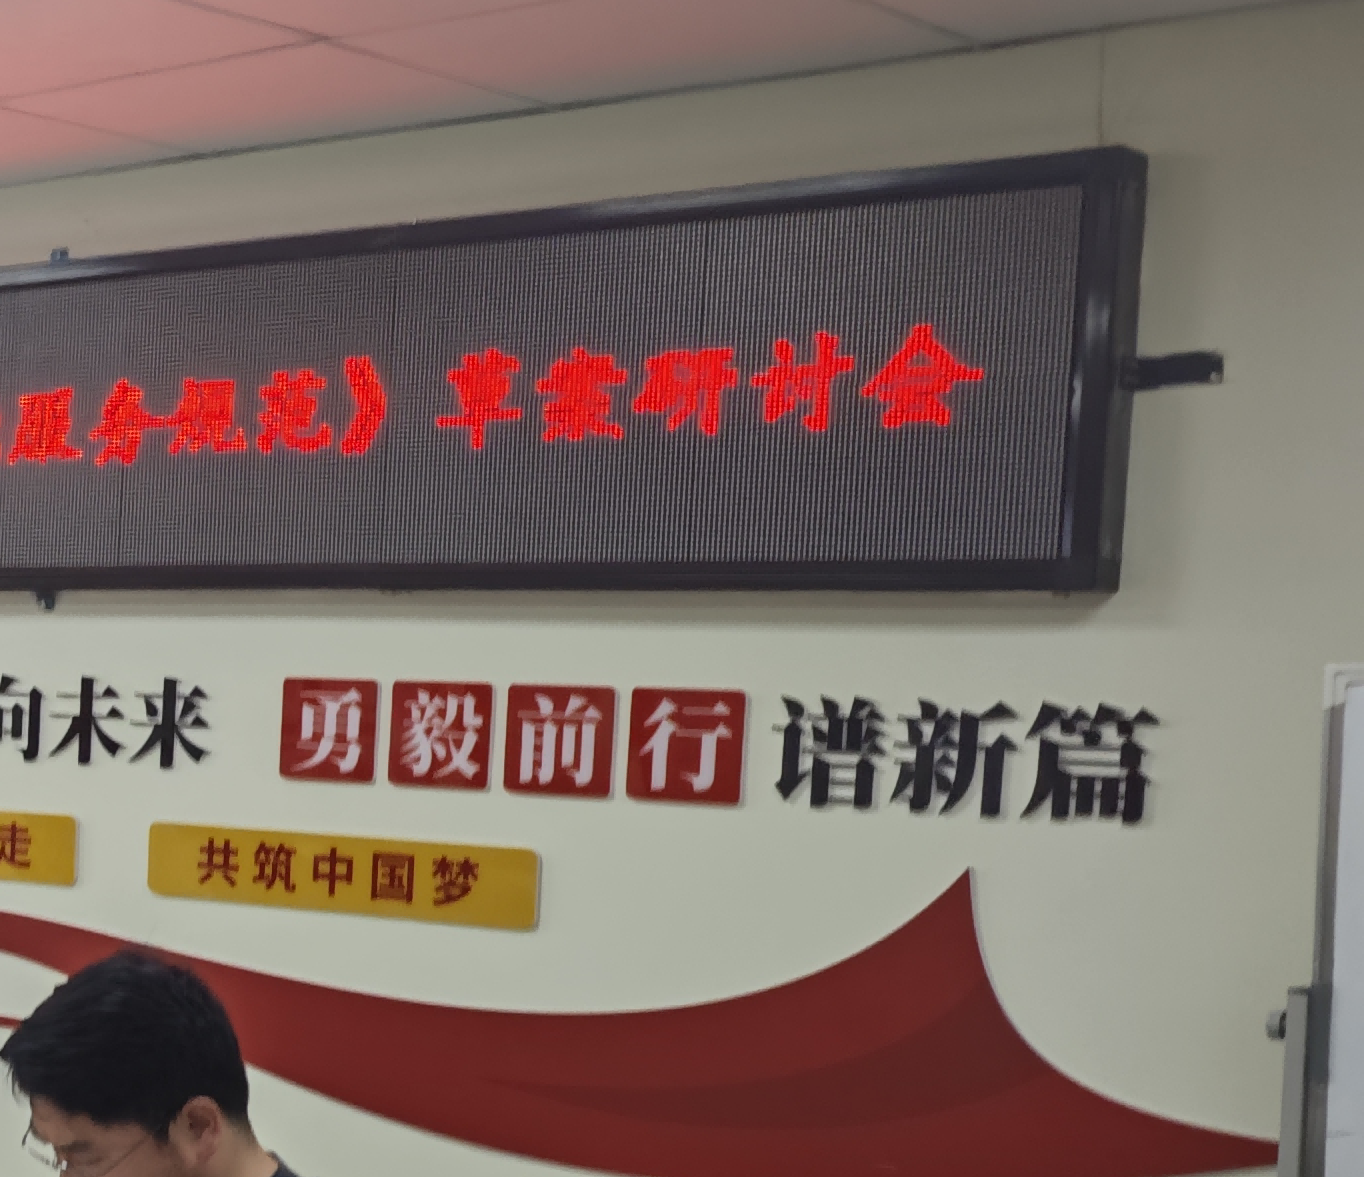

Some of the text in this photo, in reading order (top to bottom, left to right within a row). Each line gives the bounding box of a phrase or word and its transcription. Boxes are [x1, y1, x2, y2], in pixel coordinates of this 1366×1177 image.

[292, 687, 1159, 826] 勇毅前行谱新篇
[197, 836, 483, 908] 共筑中国梦
